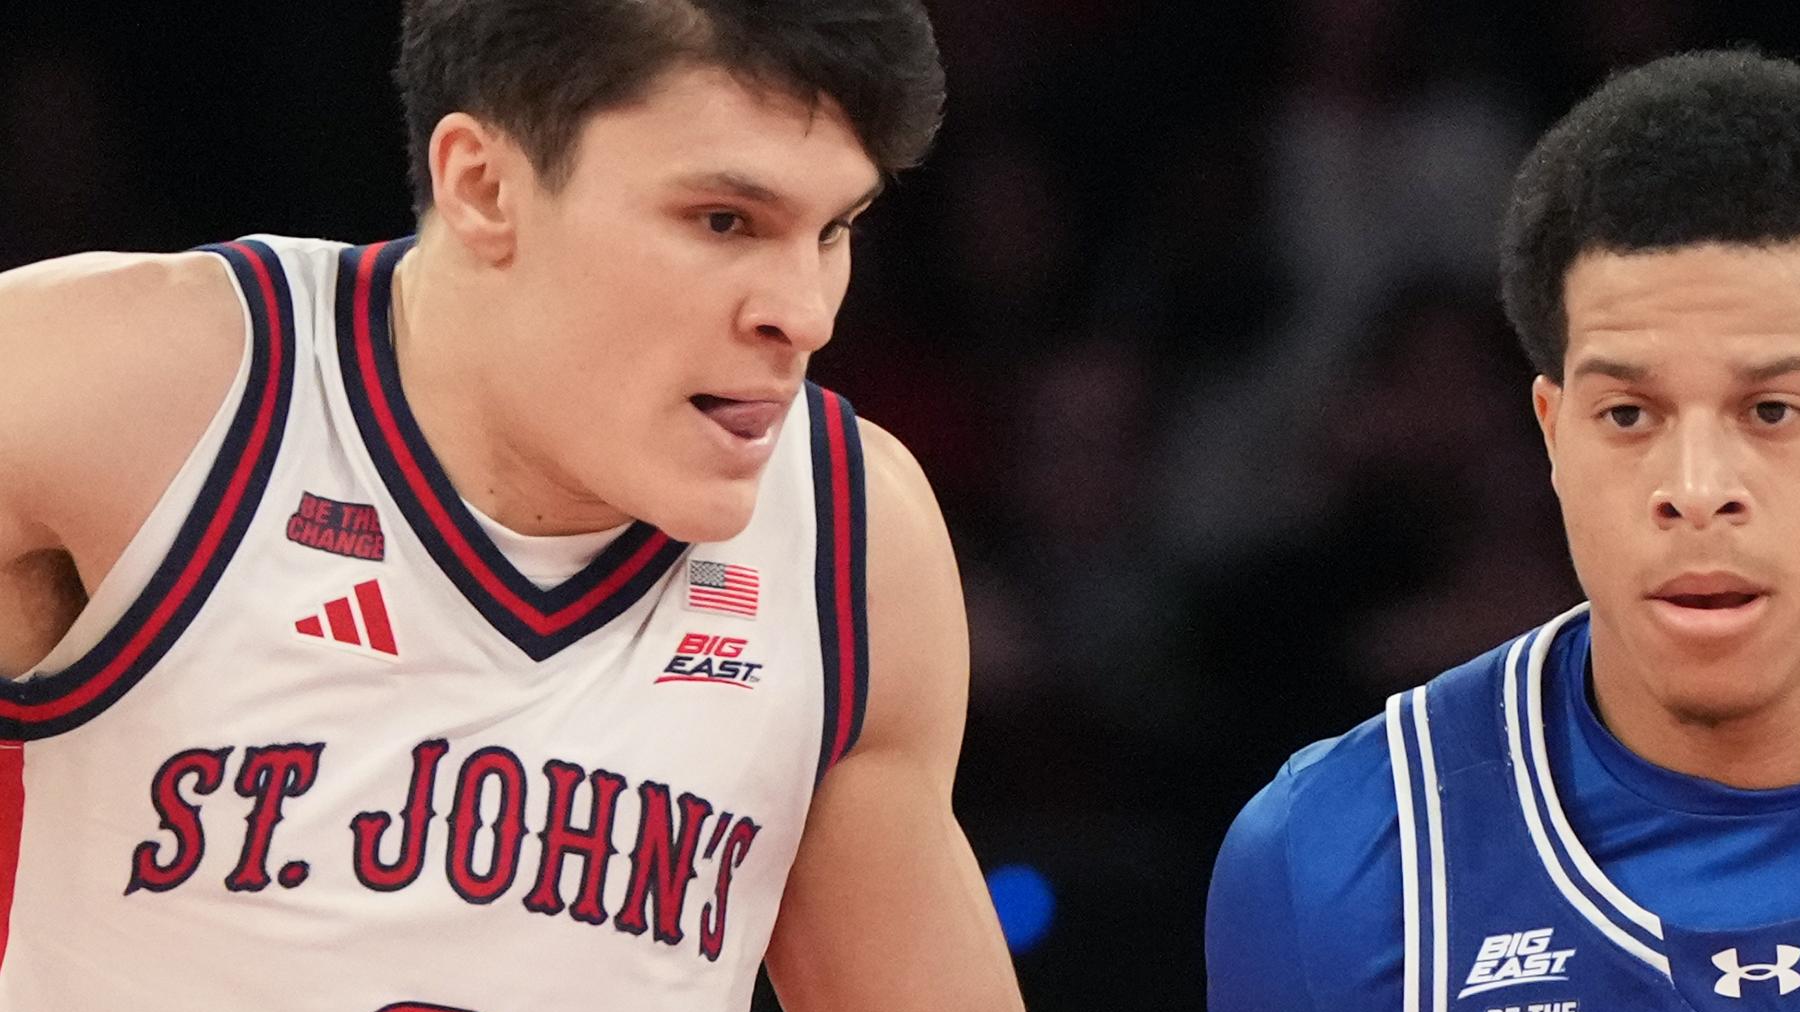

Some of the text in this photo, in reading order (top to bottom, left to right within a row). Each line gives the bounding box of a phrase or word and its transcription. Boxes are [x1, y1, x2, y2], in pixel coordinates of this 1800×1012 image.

[301, 496, 332, 525] BE
[676, 633, 749, 658] BIG
[663, 655, 763, 681] EAST
[124, 737, 762, 962] ST. JOHN'S
[1476, 928, 1554, 962] BIG
[1465, 949, 1577, 985] EAST
